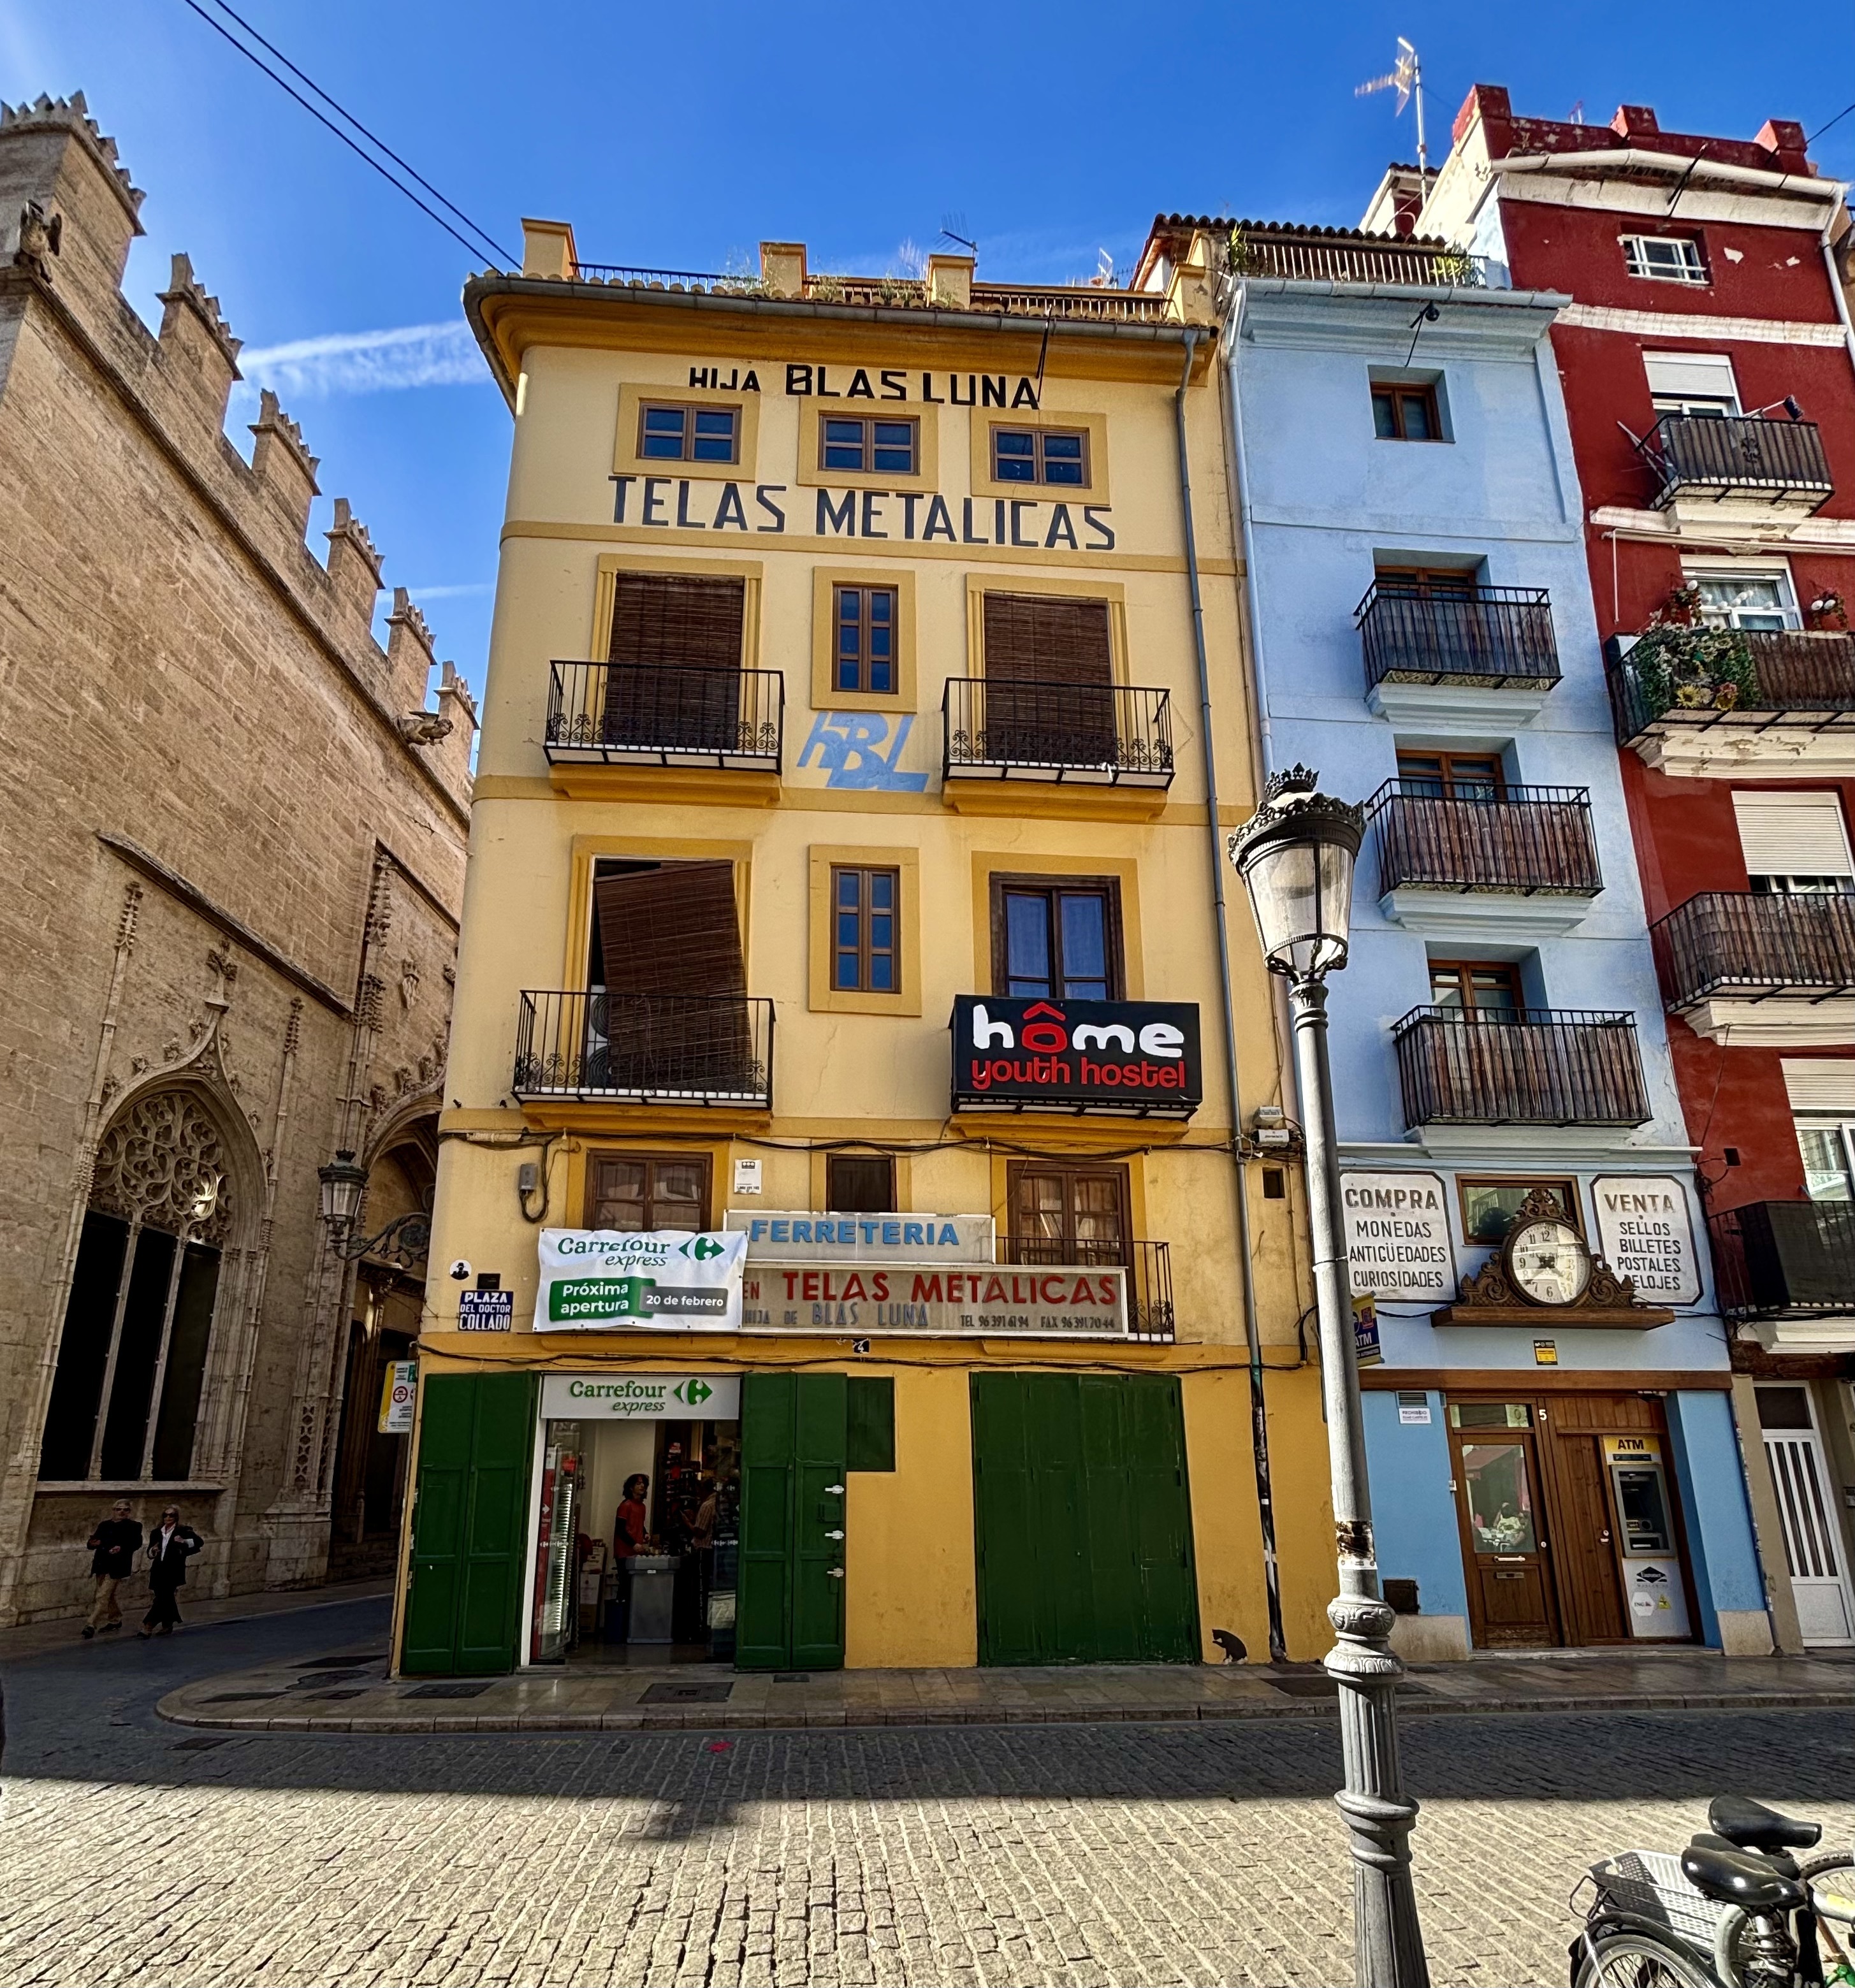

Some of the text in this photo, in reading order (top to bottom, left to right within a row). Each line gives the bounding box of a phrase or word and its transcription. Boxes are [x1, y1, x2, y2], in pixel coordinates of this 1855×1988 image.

[689, 364, 1040, 410] HIJA BLAS LUNA
[608, 475, 1116, 551] TELAS METALICAS
[972, 1056, 1185, 1091] youth hostel
[1344, 1188, 1439, 1210] COMPRA
[1604, 1194, 1676, 1213] VENTA
[751, 1219, 959, 1245] FERRETERIA
[1356, 1220, 1432, 1238] MONEDAS
[1619, 1221, 1671, 1236] SELLOS
[558, 1237, 671, 1254] Carrefour
[1349, 1242, 1446, 1263] ANTIGÜEDADES
[1619, 1238, 1681, 1254] BILLETES
[605, 1254, 668, 1272] express
[1617, 1256, 1681, 1272] POSTALES
[1353, 1270, 1443, 1288] CURIOSIDADES
[563, 1281, 629, 1297] Próxima
[743, 1272, 1116, 1305] EN TELAS METALICAS
[464, 1292, 507, 1303] PLAZA
[646, 1295, 724, 1307] 20 de febrero
[460, 1303, 511, 1313] DEL DOCTOR
[560, 1299, 629, 1316] apertura
[812, 1301, 859, 1325] BLAS
[878, 1303, 928, 1326] LUNA
[459, 1314, 511, 1330] COLLADO
[961, 1315, 975, 1327] TEL
[1040, 1316, 1058, 1328] FAX
[570, 1380, 667, 1398] Carrefour
[612, 1402, 666, 1416] express
[1539, 1409, 1547, 1421] 5
[1618, 1439, 1644, 1450] ATM
